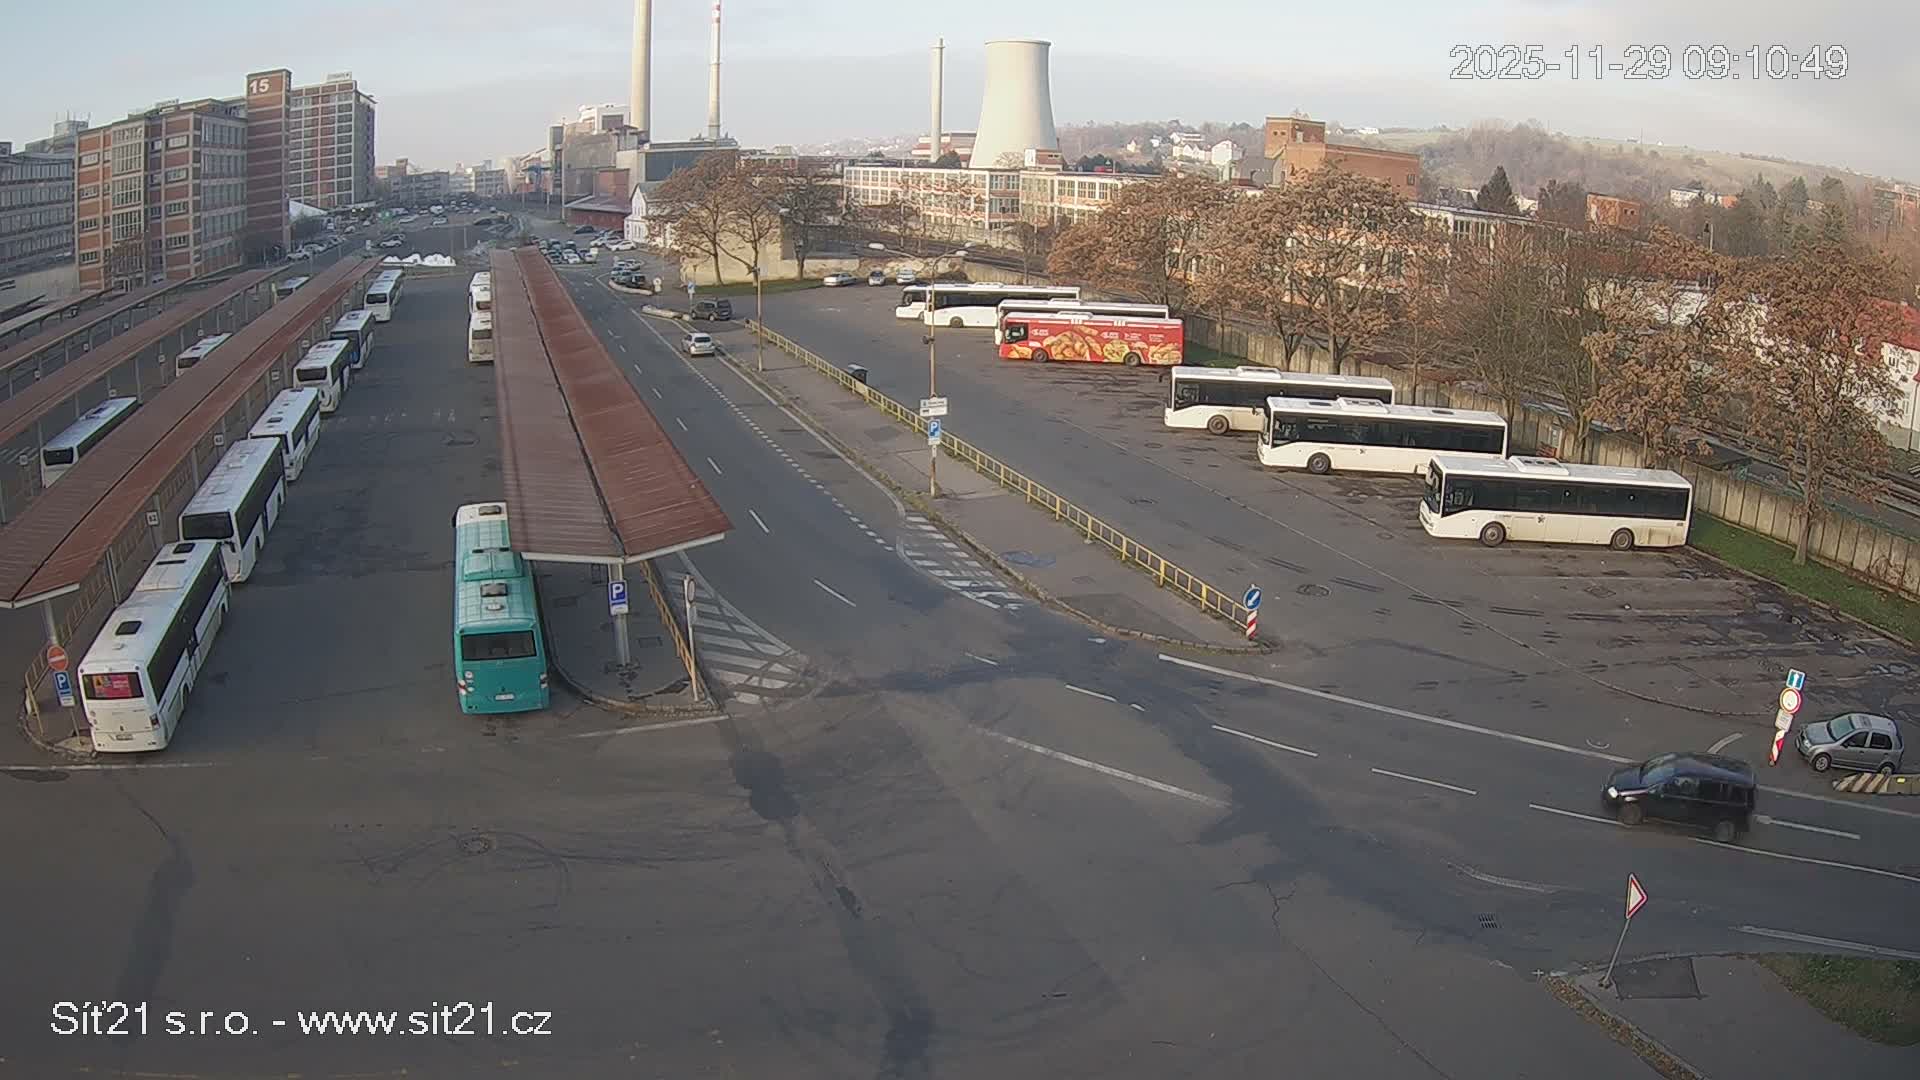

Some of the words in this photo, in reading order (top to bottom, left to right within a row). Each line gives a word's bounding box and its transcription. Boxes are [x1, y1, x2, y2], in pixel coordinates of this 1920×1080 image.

[249, 78, 270, 94] 15
[930, 421, 938, 432] P
[612, 583, 624, 600] P
[57, 673, 66, 689] P
